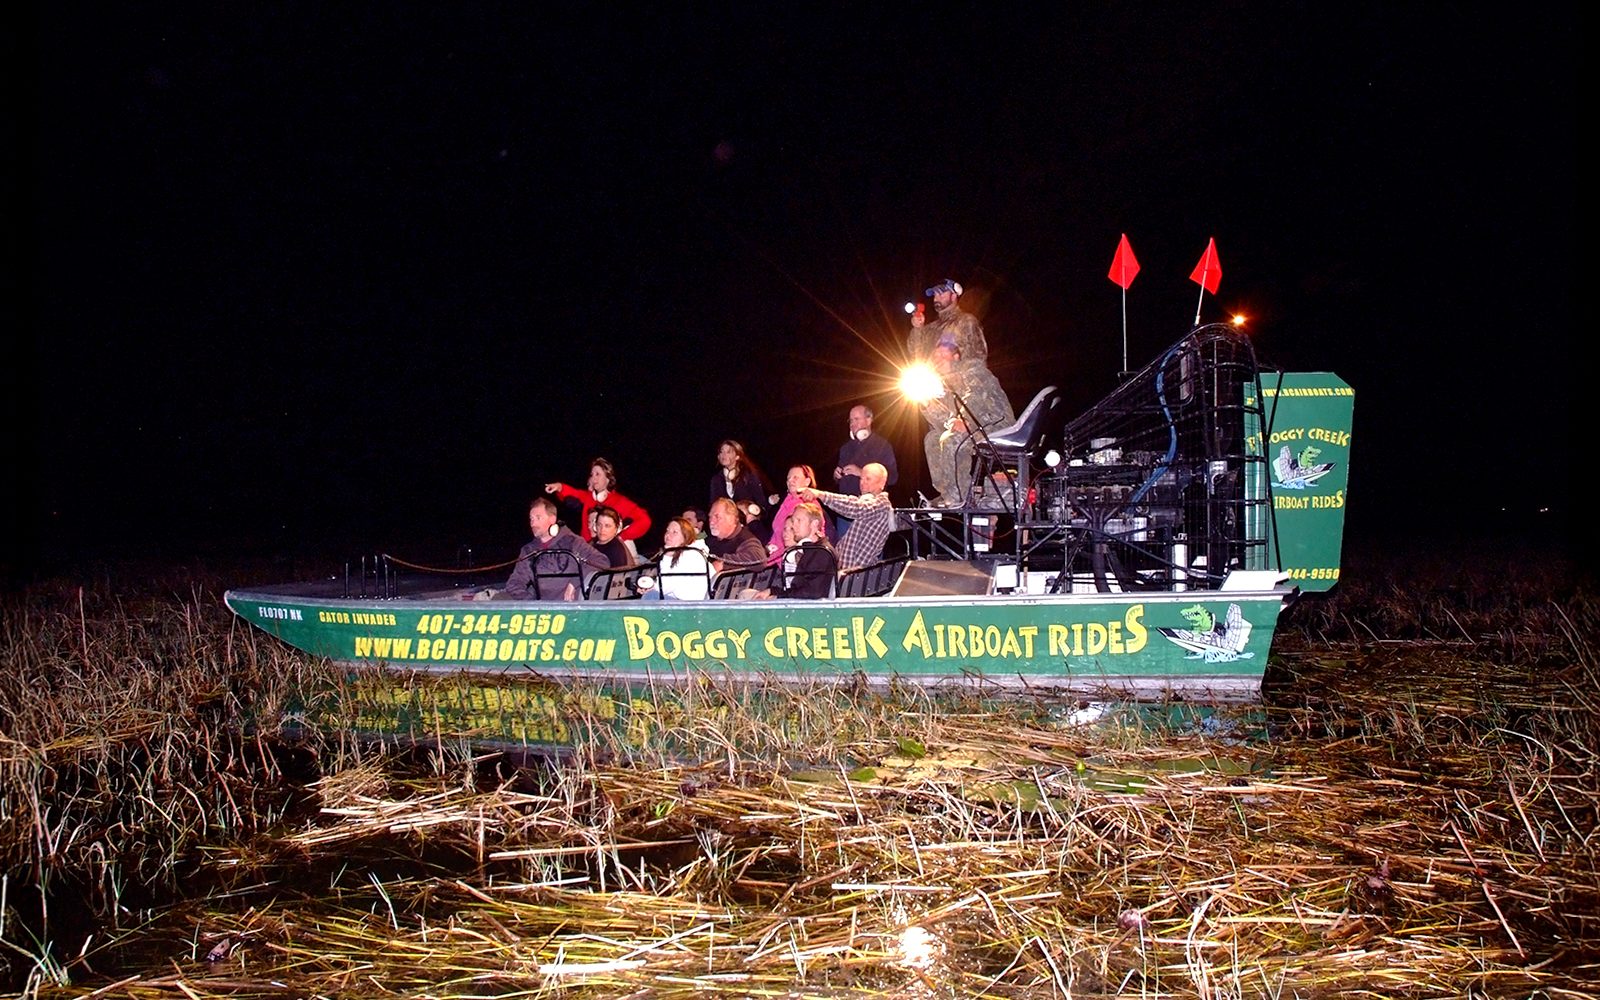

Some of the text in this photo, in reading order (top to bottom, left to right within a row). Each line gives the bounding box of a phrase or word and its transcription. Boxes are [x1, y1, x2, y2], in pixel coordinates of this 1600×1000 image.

[1262, 429, 1304, 444] OGGY
[1308, 428, 1350, 447] CREEK
[1274, 490, 1344, 509] IRBOAT RIDES
[319, 611, 397, 626] GATOR INVADER
[416, 614, 566, 635] 407-344-9550
[623, 604, 1148, 660] BOGGY CREEK AIRBOAT RIDES
[355, 637, 617, 662] WWW.BCAIRBOATS.COM
